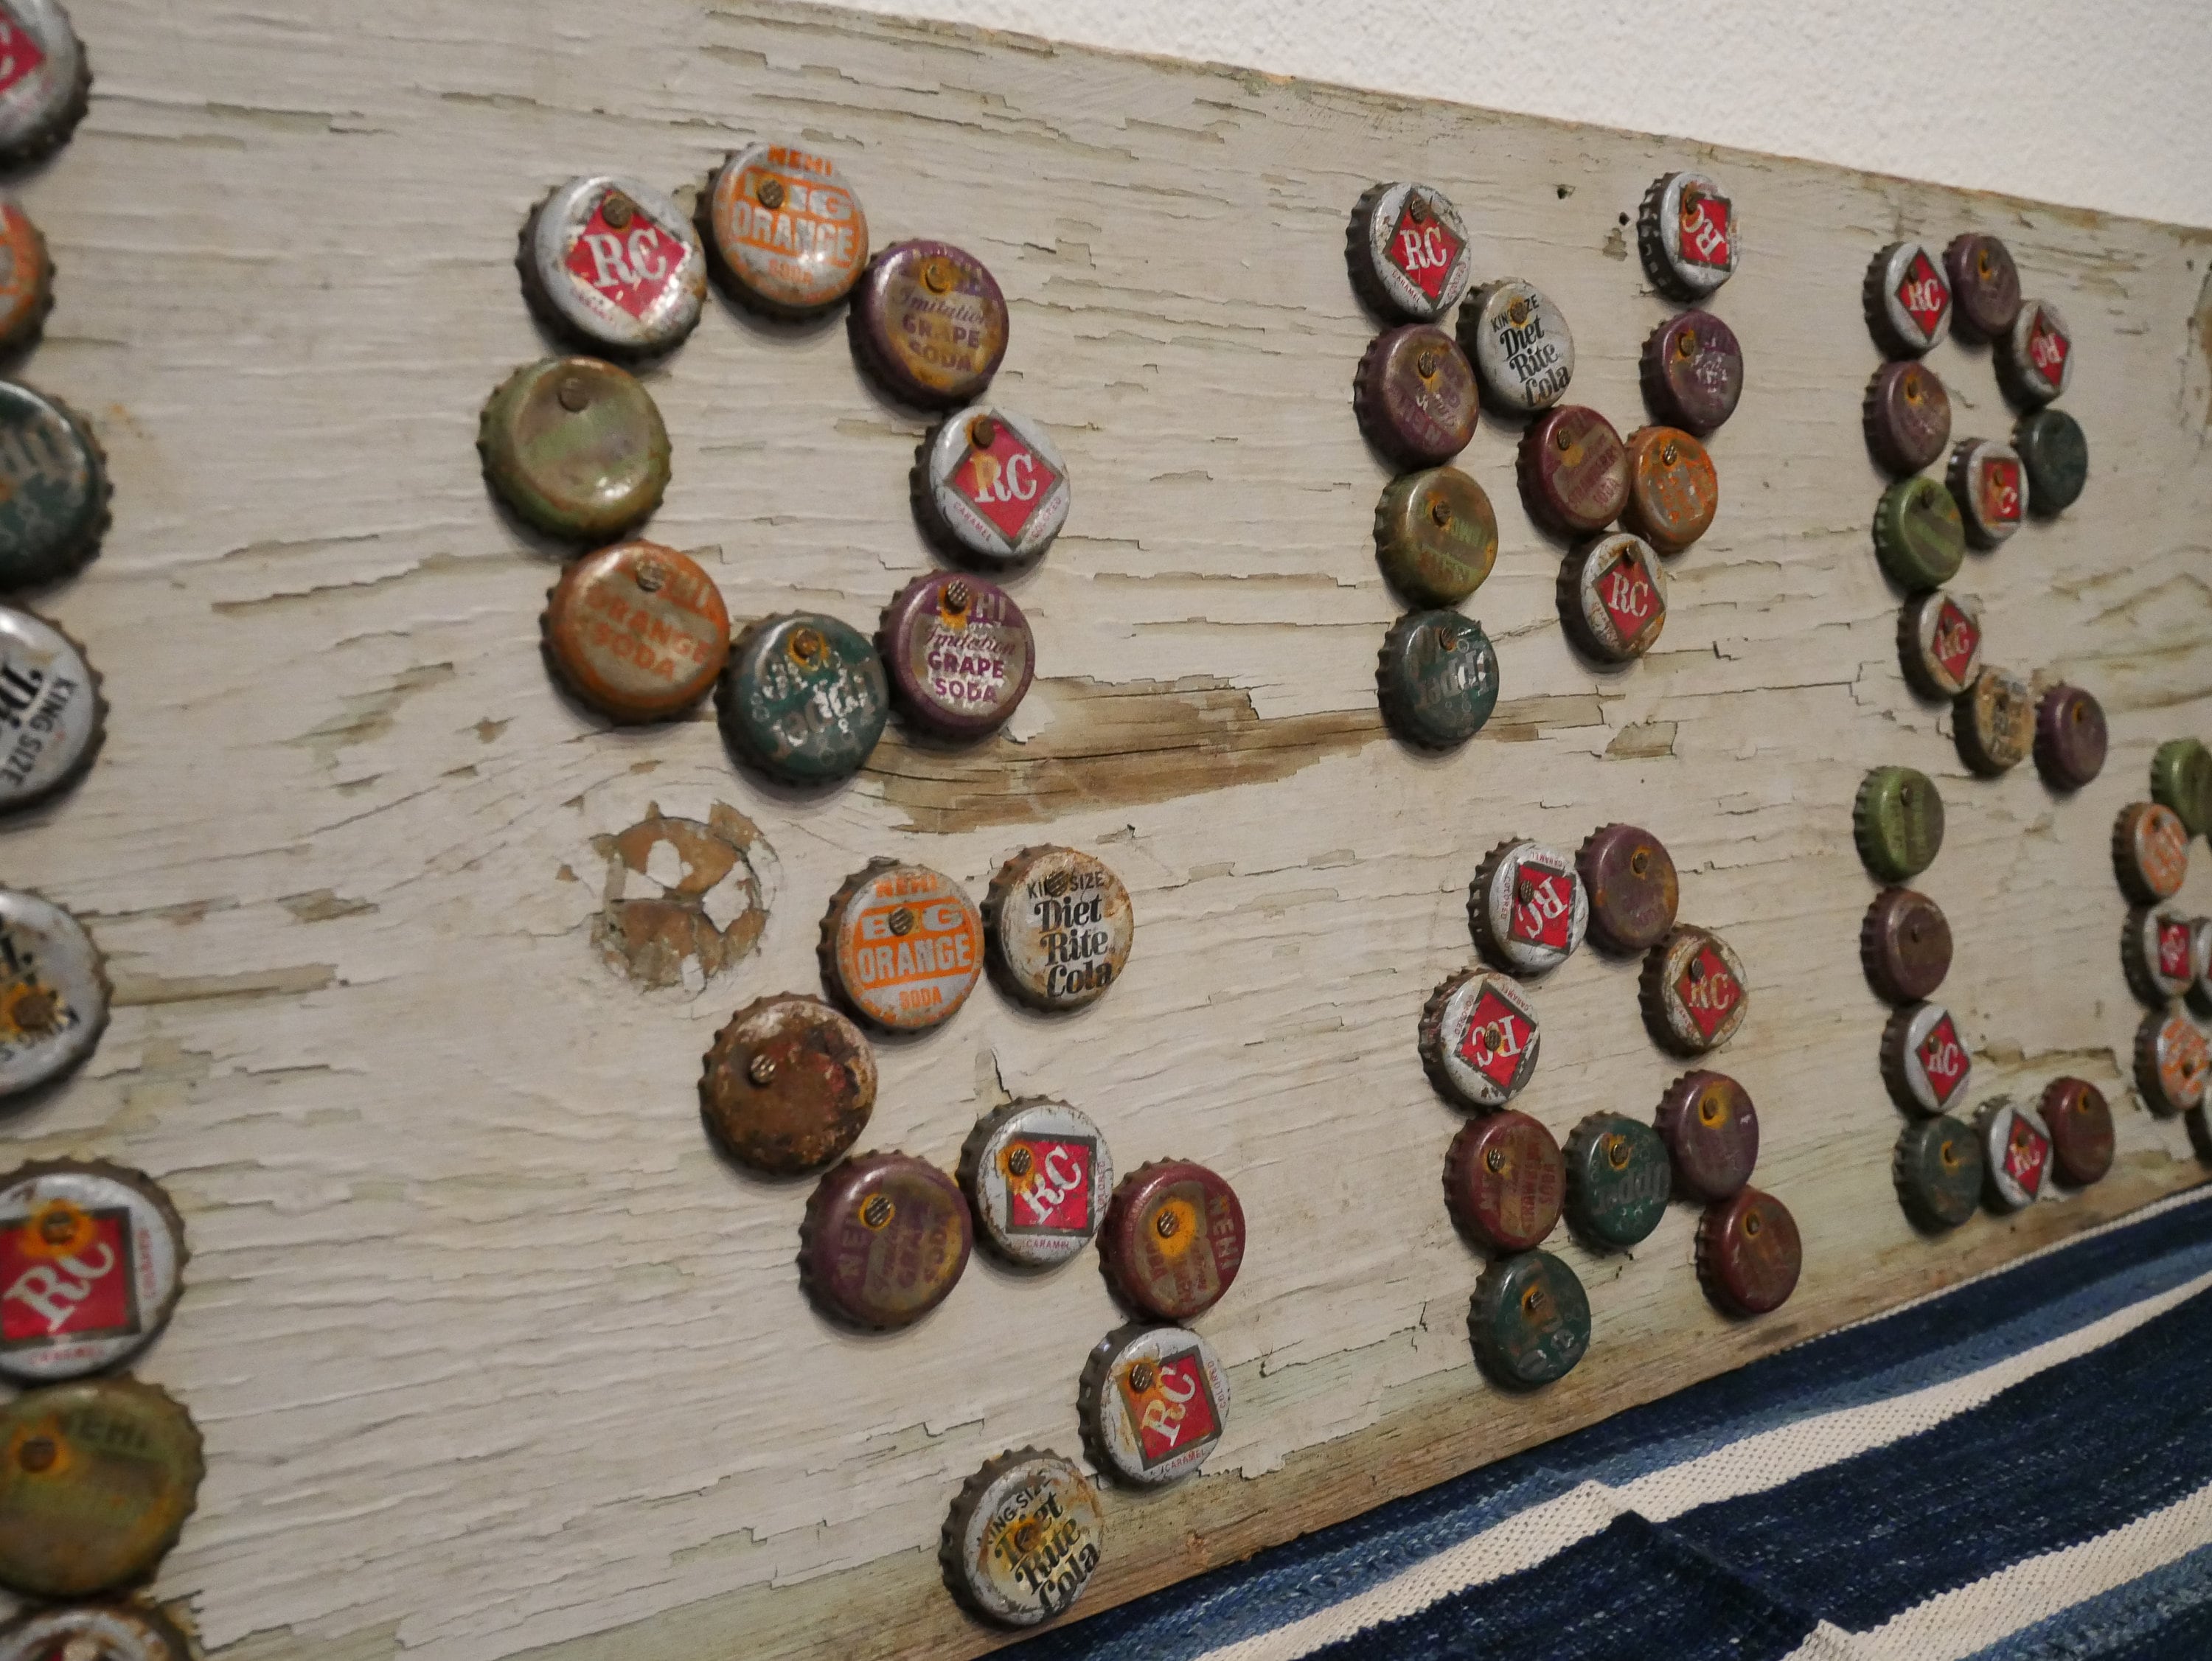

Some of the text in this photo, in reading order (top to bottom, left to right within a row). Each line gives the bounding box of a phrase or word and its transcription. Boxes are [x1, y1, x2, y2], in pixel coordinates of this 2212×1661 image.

[731, 201, 854, 262] ORANGE
[1399, 226, 1447, 271] RC
[583, 229, 667, 288] RC
[1907, 277, 1942, 312] RC
[902, 313, 981, 349] GRPE
[1509, 344, 1559, 383] Rite
[1526, 366, 1571, 407] Cola
[970, 451, 1037, 504] RC
[953, 501, 992, 543] CARAMEL
[1608, 571, 1649, 617] RC
[928, 650, 1005, 679] GRAPE
[935, 677, 997, 705] SODA
[1069, 870, 1105, 892] SIZE
[1034, 894, 1103, 935] Diet
[1517, 876, 1568, 939] RC
[858, 933, 972, 984] ORANGE
[1040, 928, 1109, 967] Rite
[1047, 959, 1113, 999] Cola
[1020, 1145, 1082, 1225] RC
[1210, 1194, 1242, 1271] NEHI
[3, 1242, 114, 1333] RC
[1142, 1365, 1196, 1447] RC
[1164, 1449, 1206, 1473] CARAMEL
[1015, 1518, 1081, 1596] Rite
[1040, 1542, 1101, 1616] Cola
